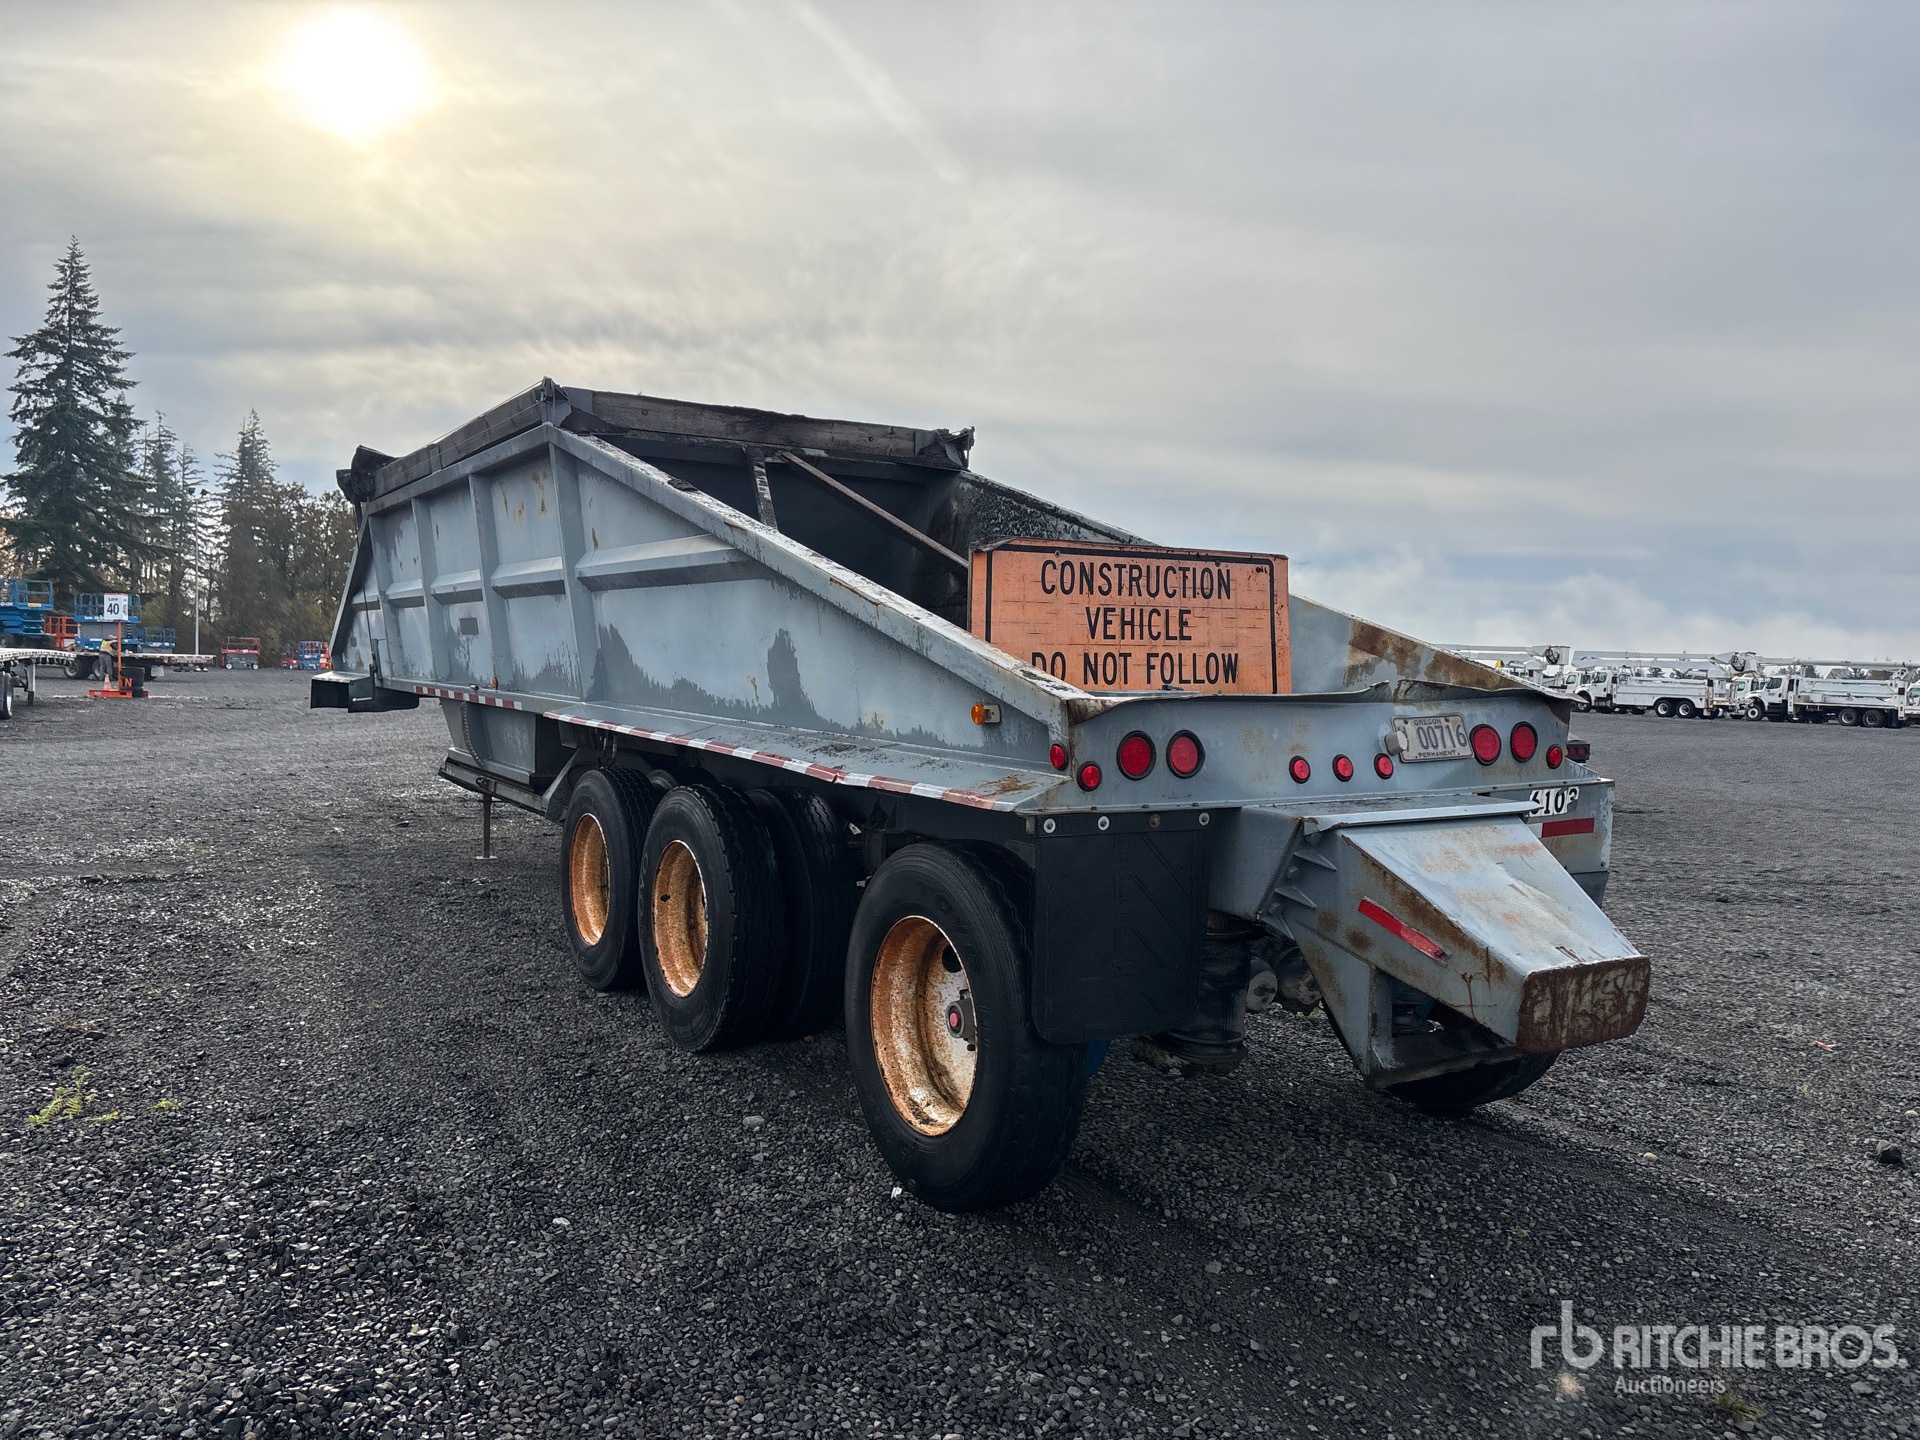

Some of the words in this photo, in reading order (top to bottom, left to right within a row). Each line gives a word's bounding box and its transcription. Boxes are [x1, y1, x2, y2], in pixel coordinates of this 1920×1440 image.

[1041, 559, 1231, 599] CONSTRUCTION
[107, 603, 119, 615] 40
[1085, 607, 1192, 641] VEHICLE
[1031, 652, 1066, 681] DO
[1083, 652, 1132, 685] NOT
[1146, 652, 1239, 685] FOLLOW
[1413, 718, 1442, 726] OREGON
[1416, 724, 1467, 750] 00716
[1417, 750, 1457, 758] PERMANENT
